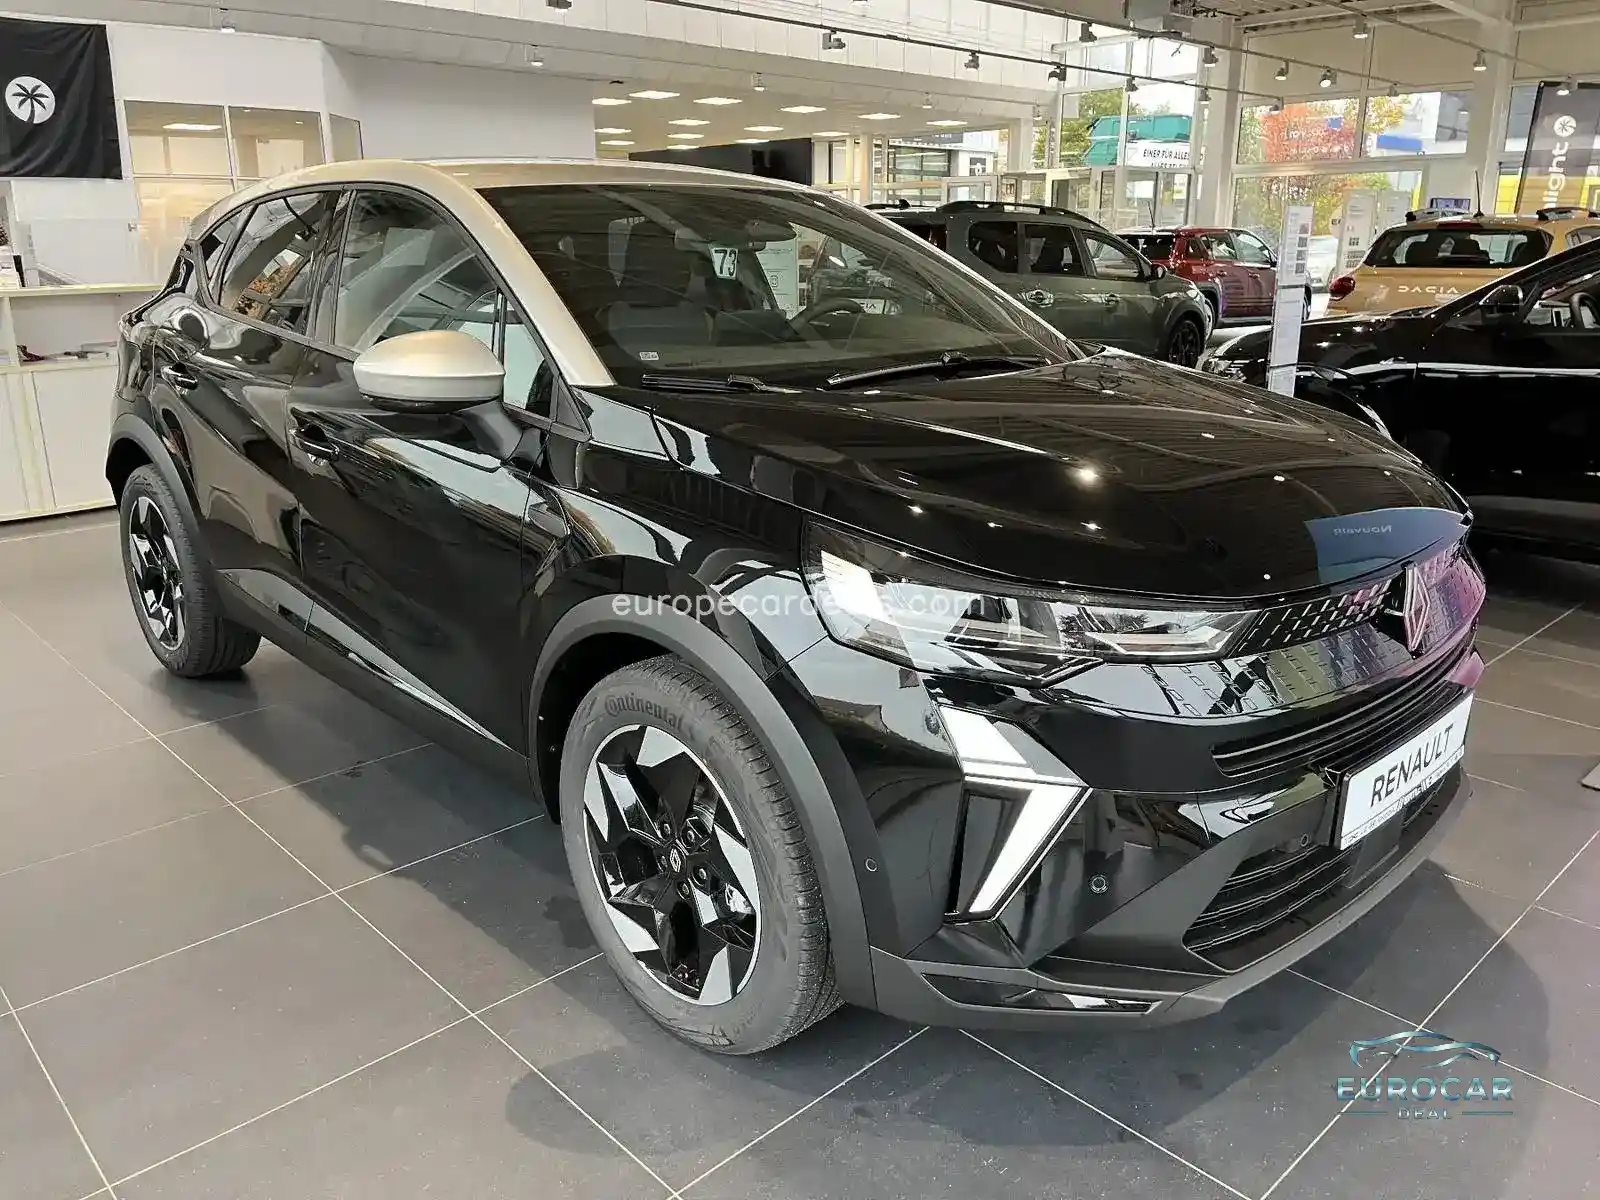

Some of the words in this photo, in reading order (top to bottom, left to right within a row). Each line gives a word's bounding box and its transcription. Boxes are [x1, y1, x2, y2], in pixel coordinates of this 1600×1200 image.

[714, 249, 737, 276] 73
[1397, 285, 1459, 294] DACIA
[604, 693, 684, 732] Continental
[1370, 723, 1454, 808] RENAULT
